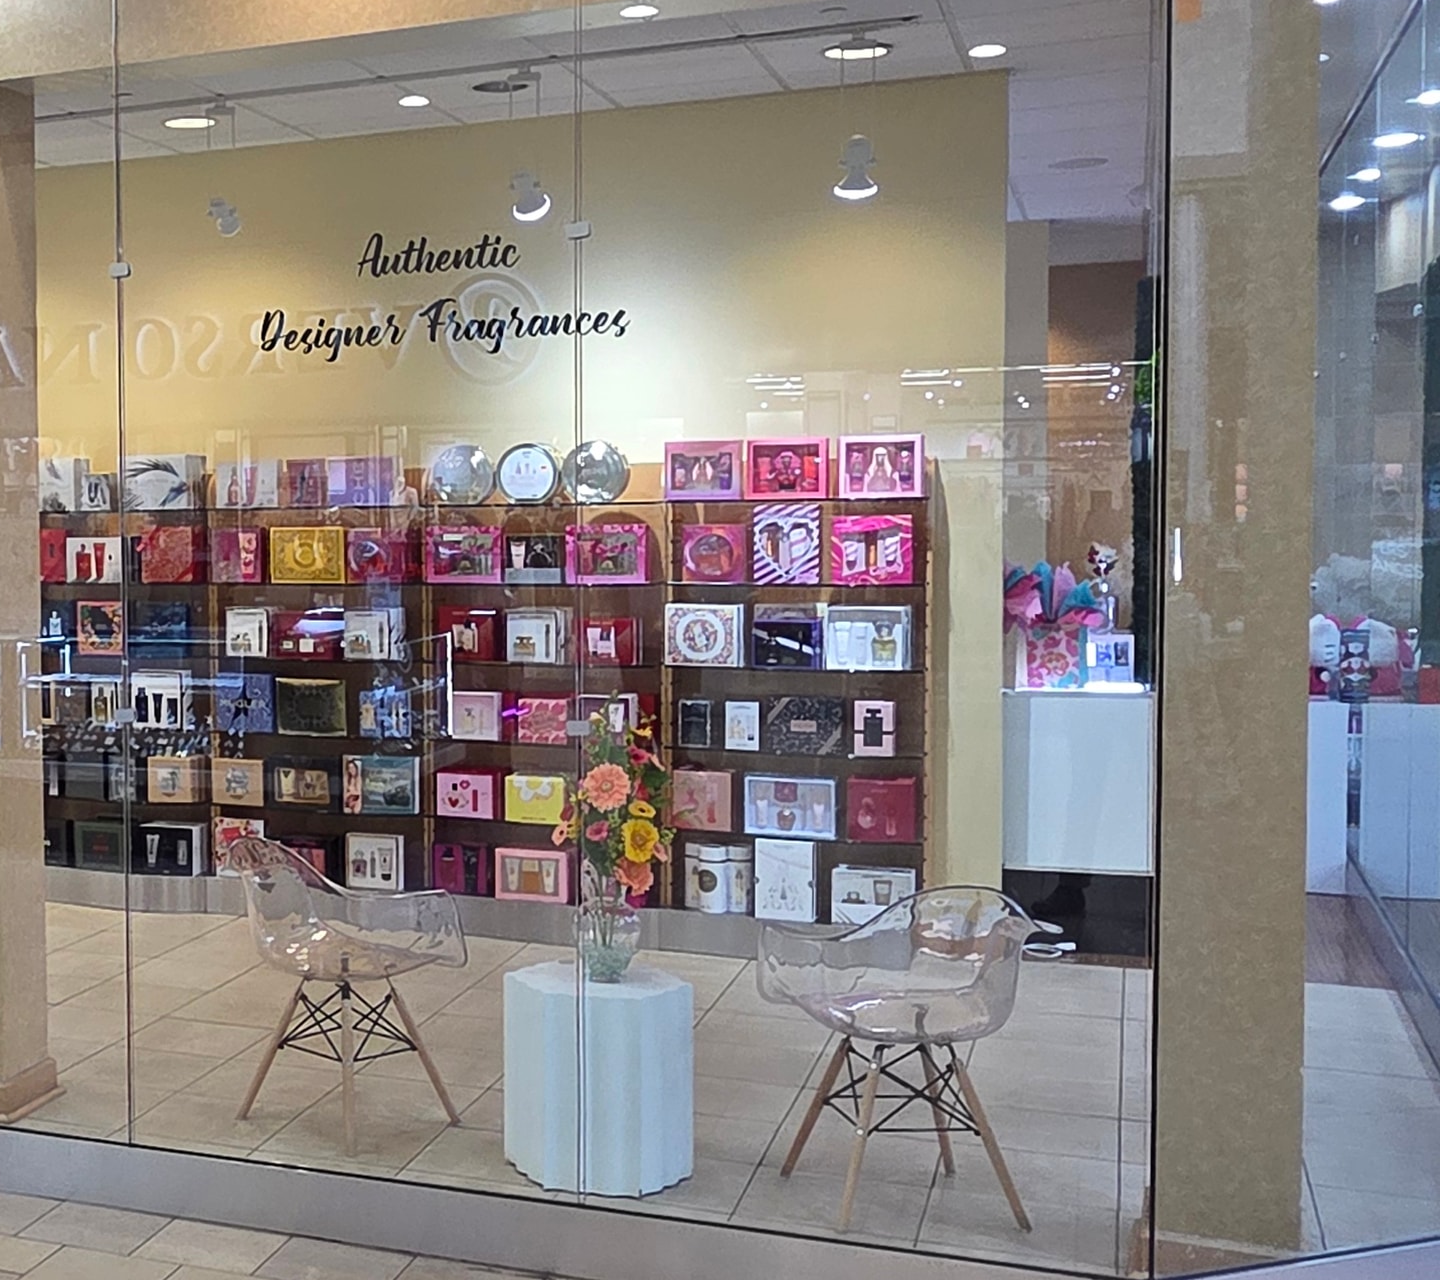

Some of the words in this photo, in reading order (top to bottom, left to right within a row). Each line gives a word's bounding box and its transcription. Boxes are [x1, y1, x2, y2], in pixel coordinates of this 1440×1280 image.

[357, 233, 520, 278] Authentic
[260, 308, 407, 362] Designer
[418, 297, 631, 353] Fragrances
